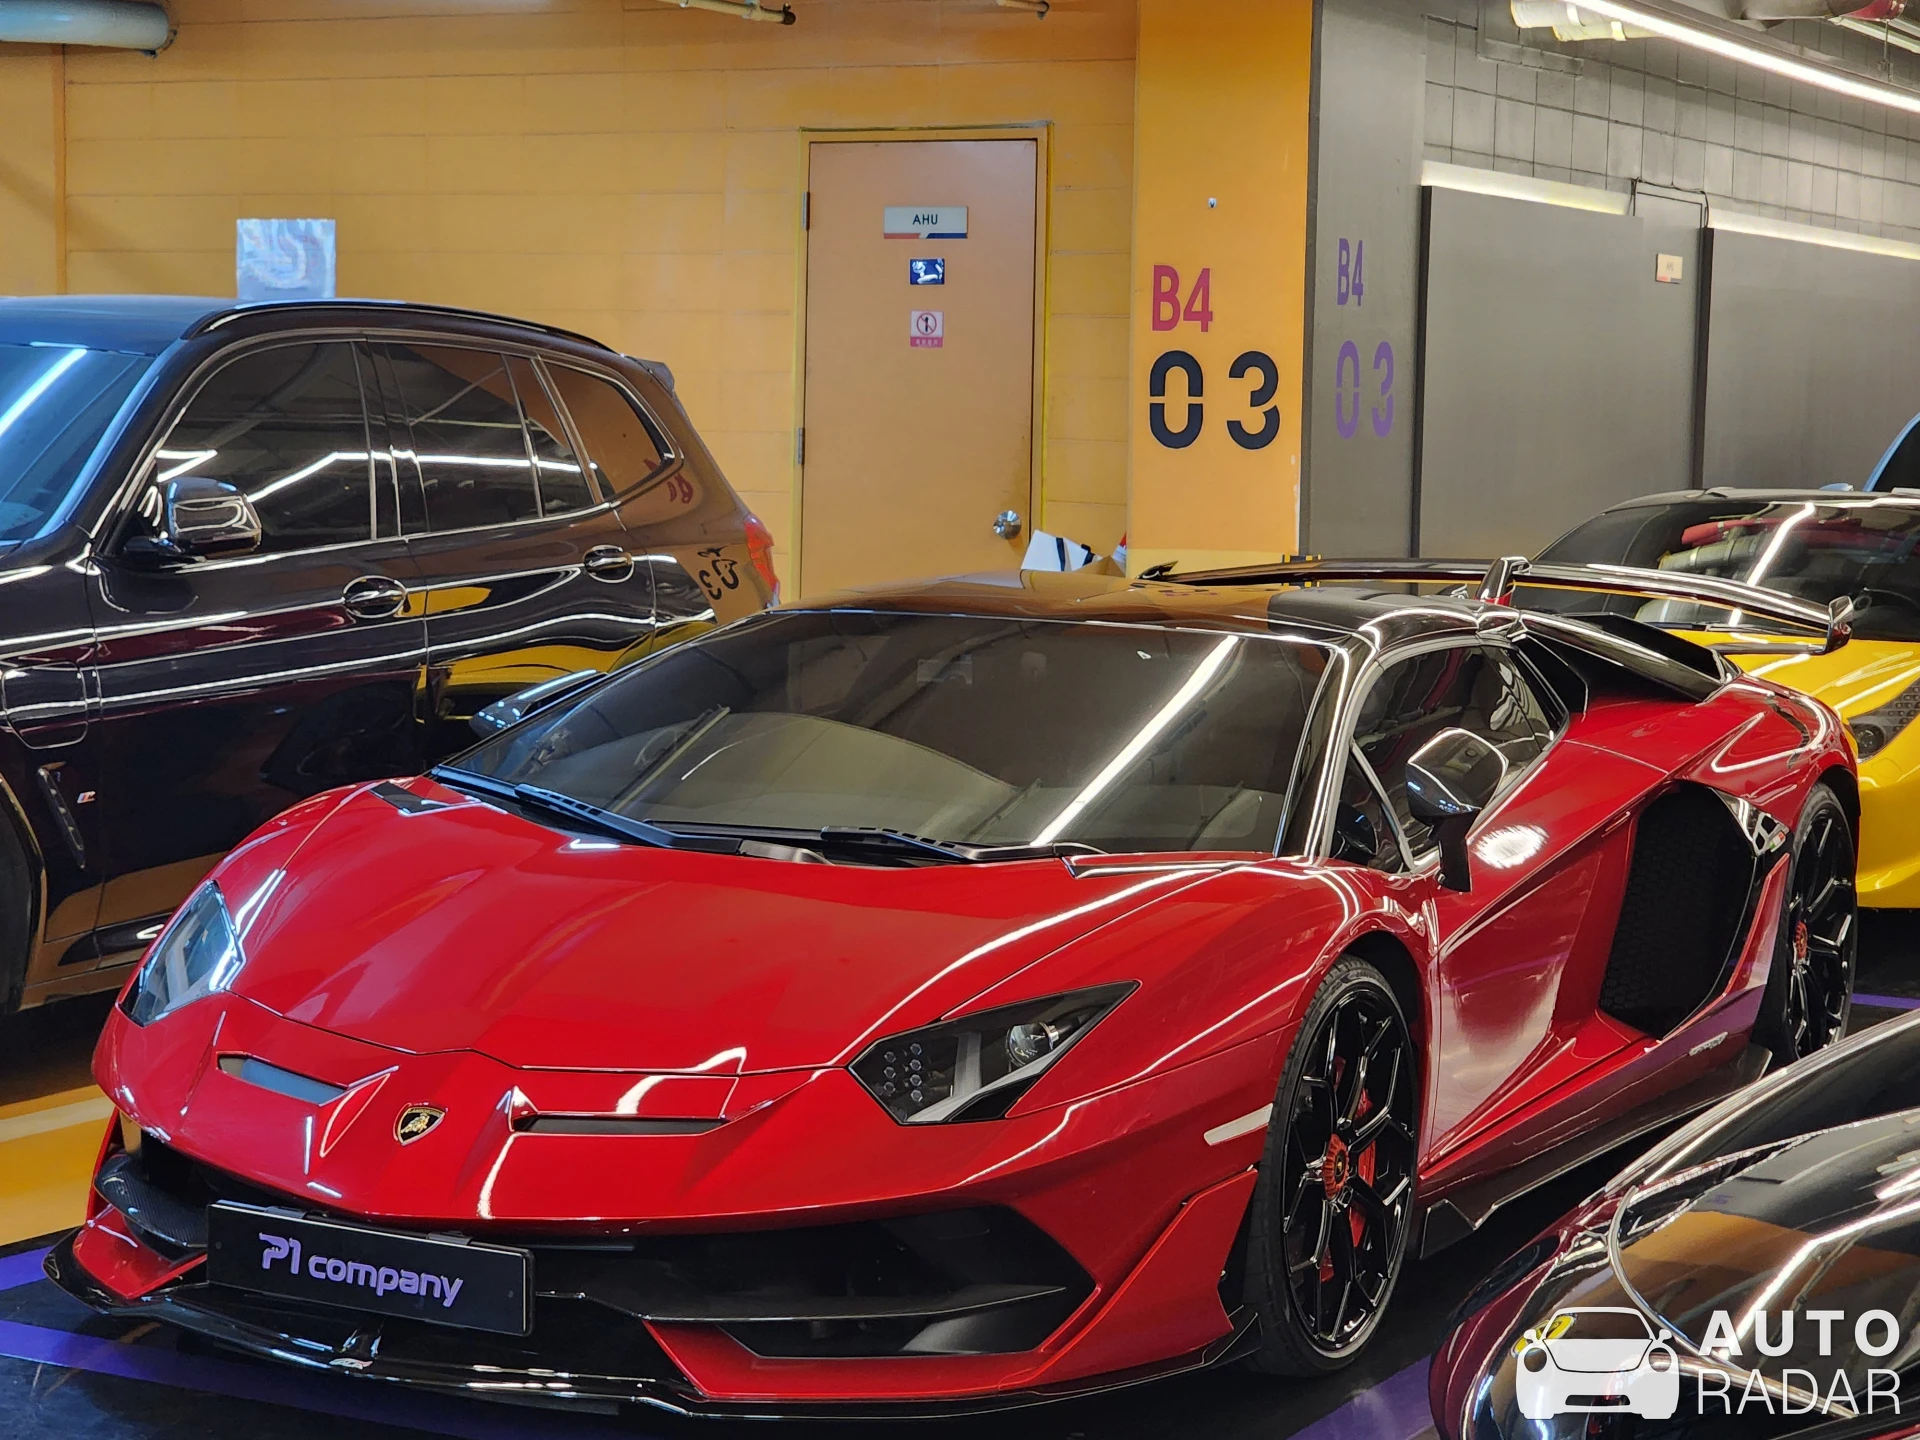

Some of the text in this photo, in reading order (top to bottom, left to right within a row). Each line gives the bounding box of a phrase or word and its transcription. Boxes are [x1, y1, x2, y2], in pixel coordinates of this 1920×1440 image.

[912, 213, 938, 225] AHU
[1152, 264, 1213, 333] B4
[1337, 237, 1364, 307] B4
[308, 1254, 464, 1308] company
